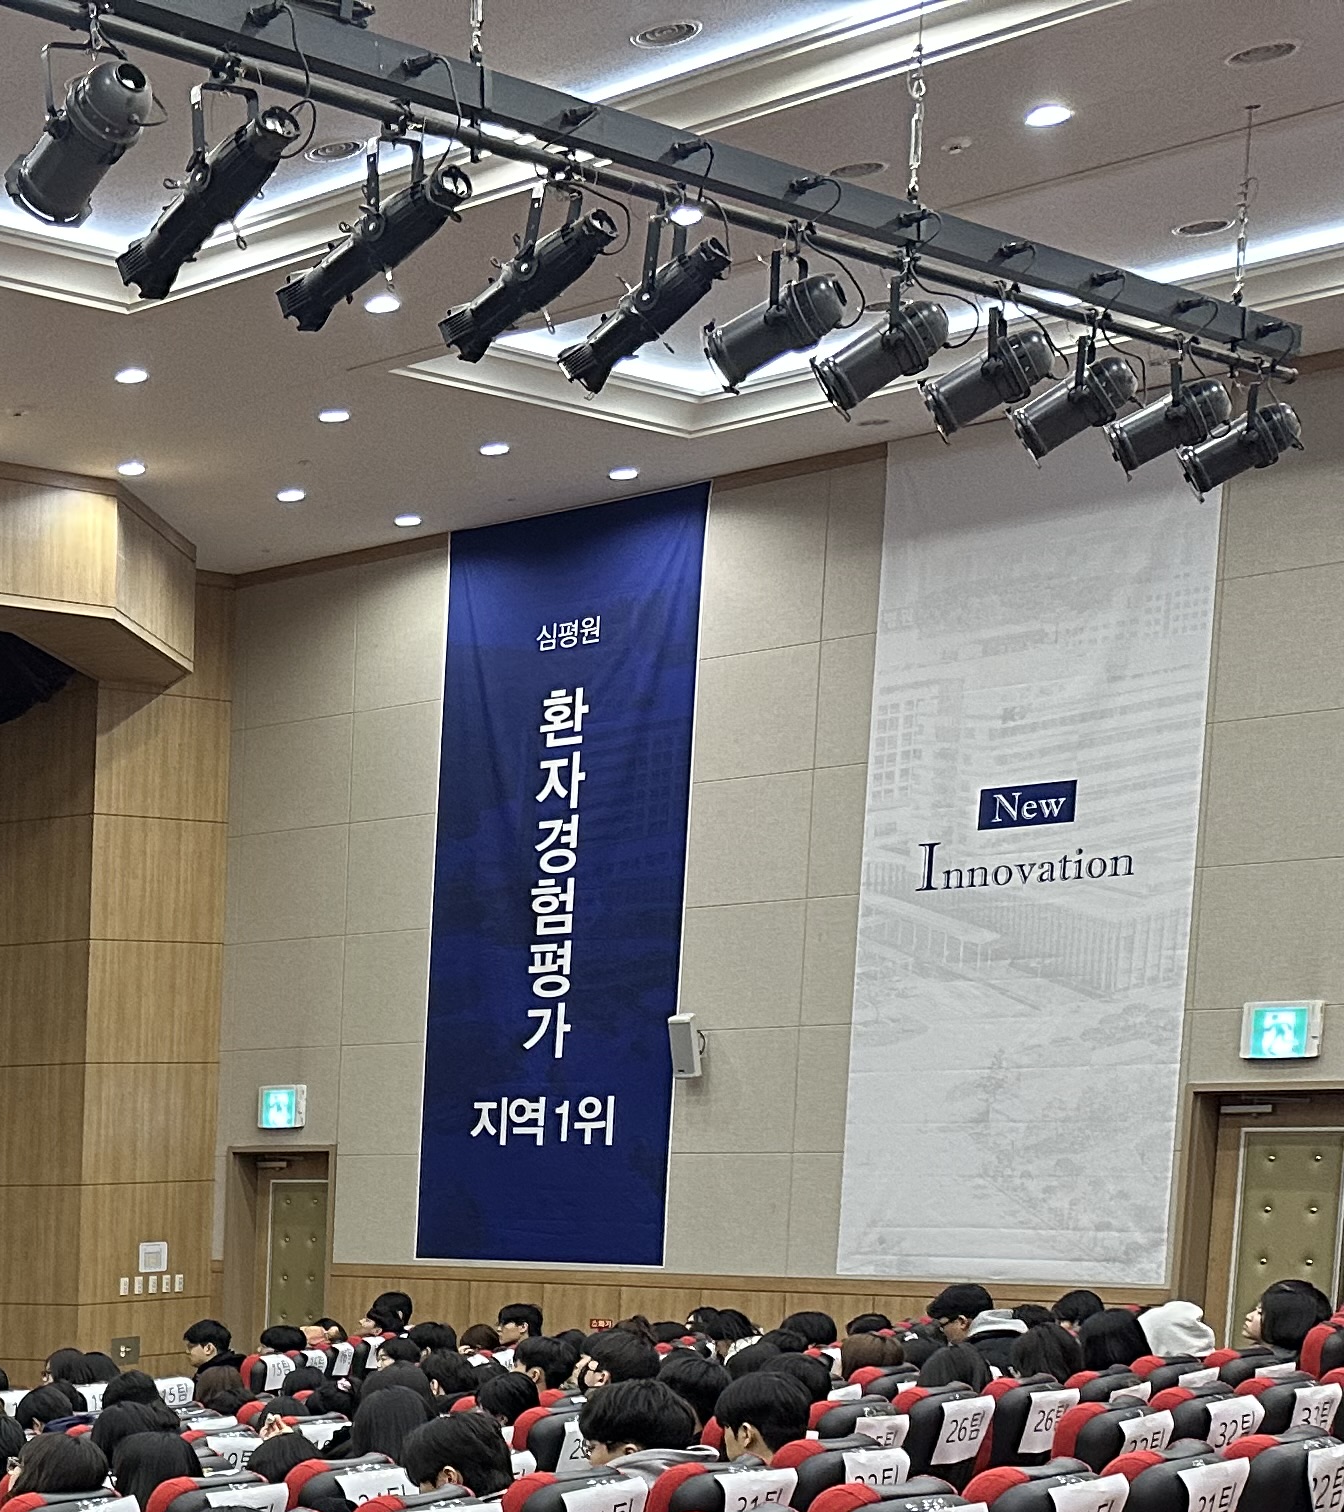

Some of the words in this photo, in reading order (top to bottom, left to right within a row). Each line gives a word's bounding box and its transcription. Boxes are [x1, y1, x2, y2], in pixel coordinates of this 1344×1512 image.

[535, 615, 602, 652] 심평원
[990, 791, 1068, 825] New
[914, 840, 1135, 893] Innovation
[945, 1410, 986, 1444] 26팀
[1214, 1410, 1256, 1448] 32팀
